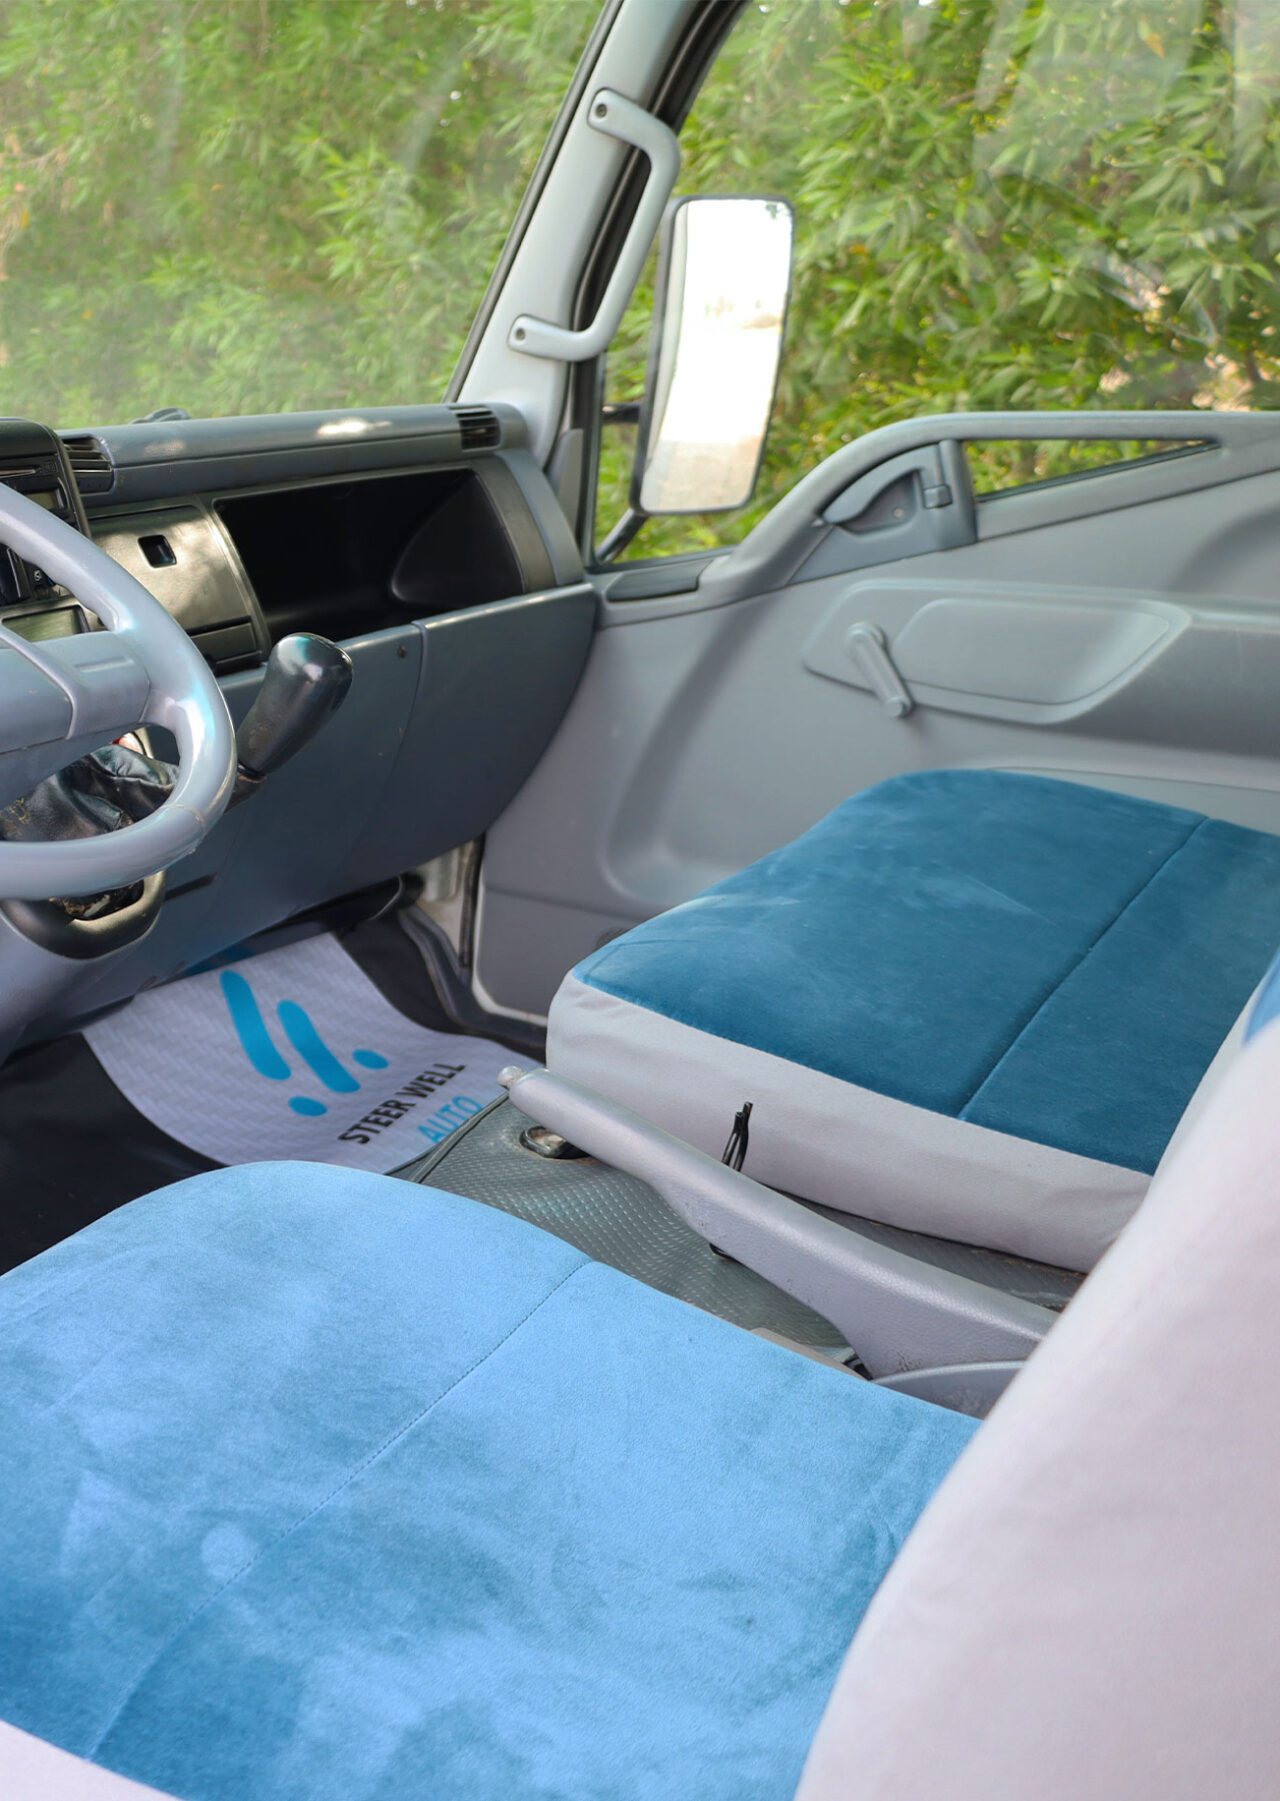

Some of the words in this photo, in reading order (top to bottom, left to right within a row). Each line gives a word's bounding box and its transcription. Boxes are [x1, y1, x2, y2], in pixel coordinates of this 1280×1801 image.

[338, 1099, 416, 1144] STEER
[396, 1063, 466, 1099] WELL
[416, 1095, 483, 1144] AUTO
